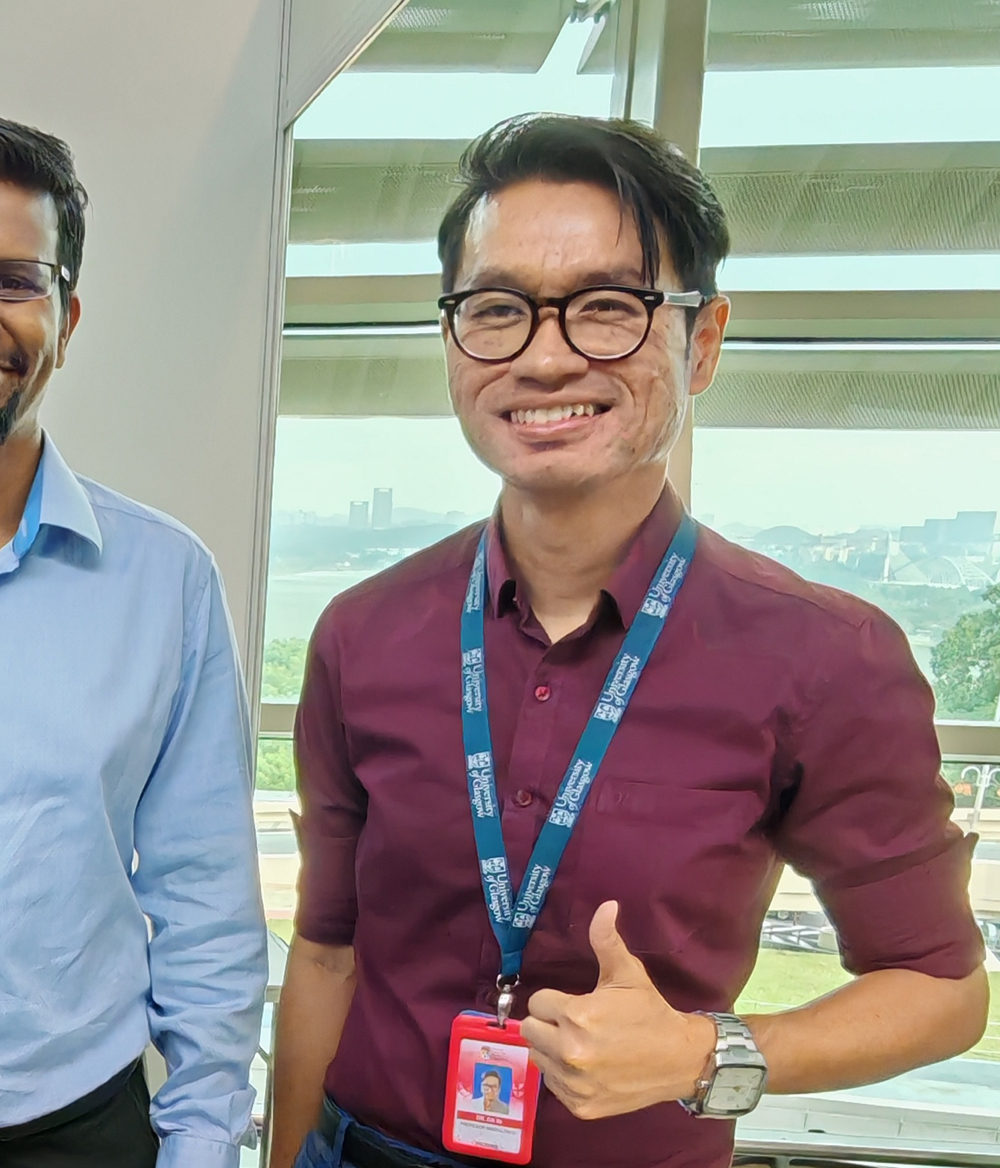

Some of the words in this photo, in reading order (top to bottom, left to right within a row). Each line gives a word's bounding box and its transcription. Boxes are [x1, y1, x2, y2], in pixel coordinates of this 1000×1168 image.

[601, 652, 632, 702] University
[480, 768, 494, 818] University
[555, 758, 586, 807] University
[496, 872, 512, 922] University
[517, 863, 543, 912] University
